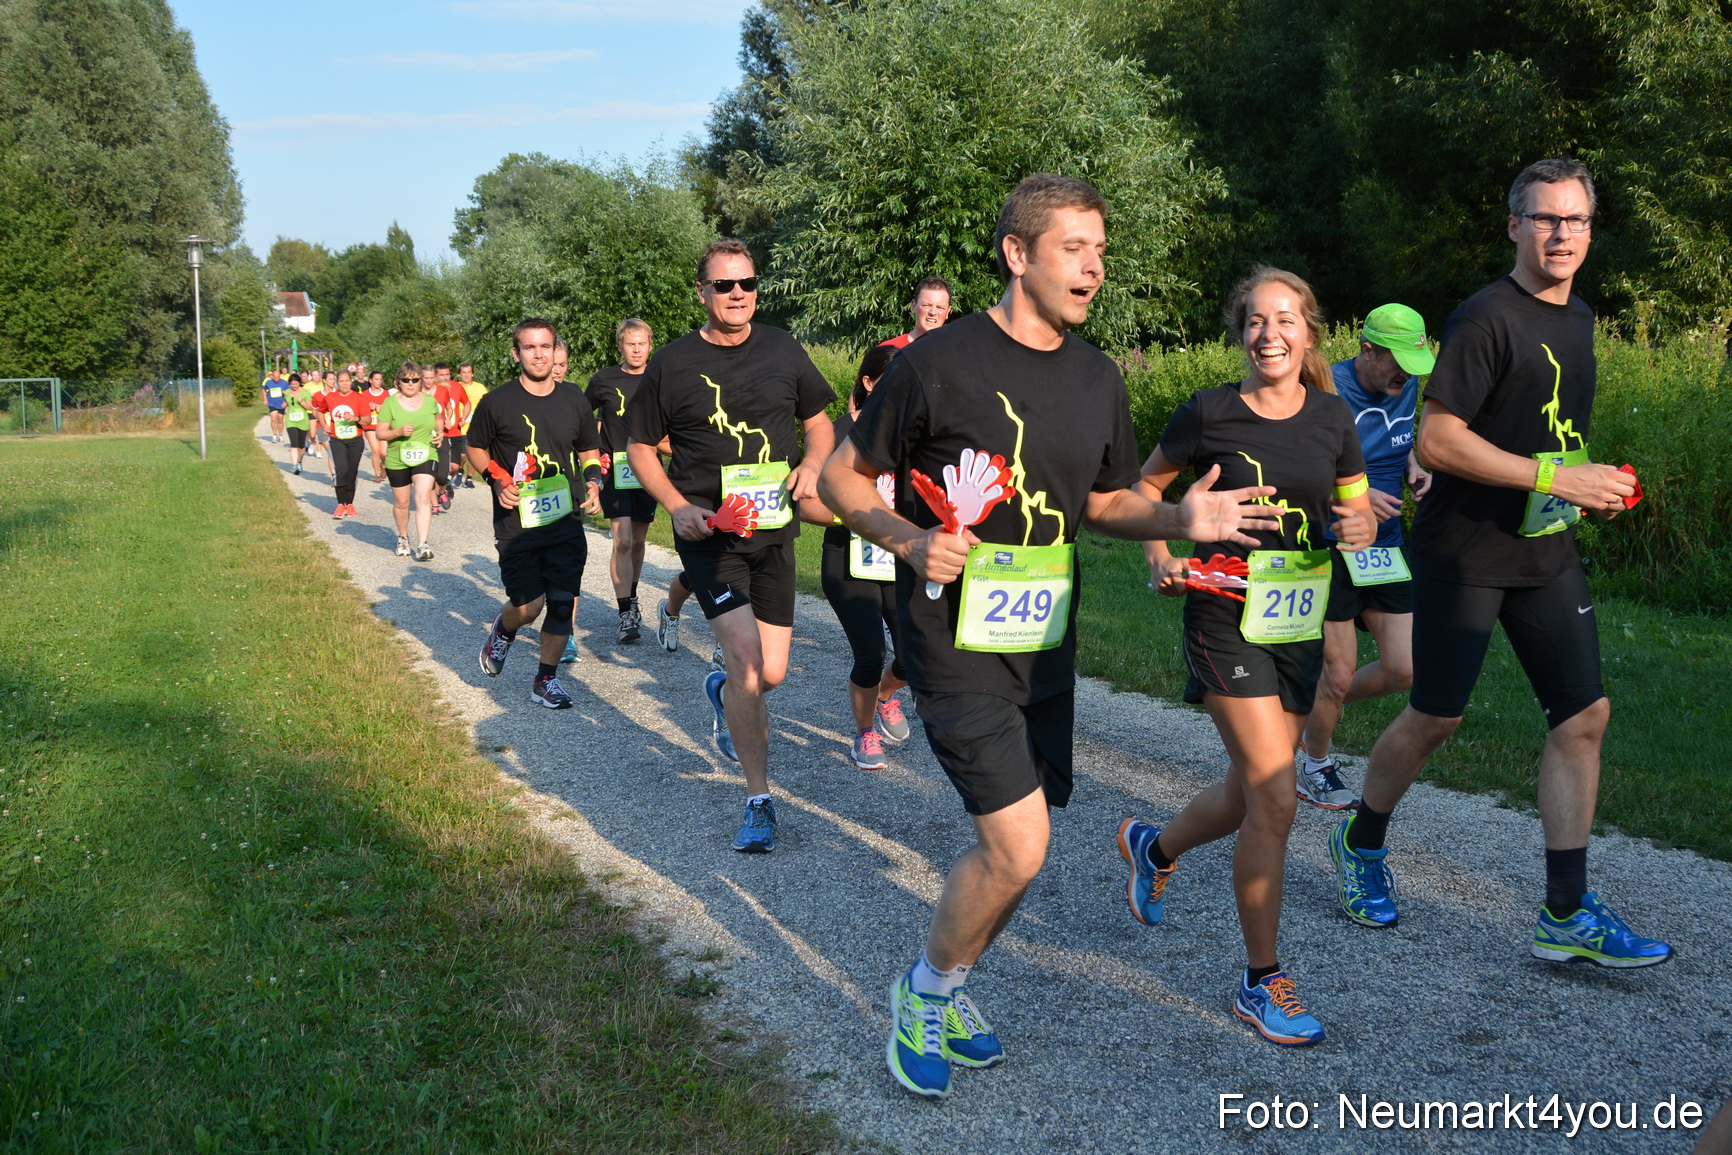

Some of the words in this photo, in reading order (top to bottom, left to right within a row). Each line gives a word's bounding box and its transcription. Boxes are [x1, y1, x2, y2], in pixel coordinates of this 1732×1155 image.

[339, 426, 353, 434] 544
[405, 451, 424, 460] 517
[530, 495, 560, 514] 251
[1541, 496, 1575, 514] 24
[985, 562, 1028, 573] firmenlauf
[1354, 548, 1393, 570] 953
[984, 589, 1052, 623] 249
[1262, 588, 1315, 618] 218
[988, 630, 1017, 638] Manfred
[1018, 630, 1044, 638] Kienlein
